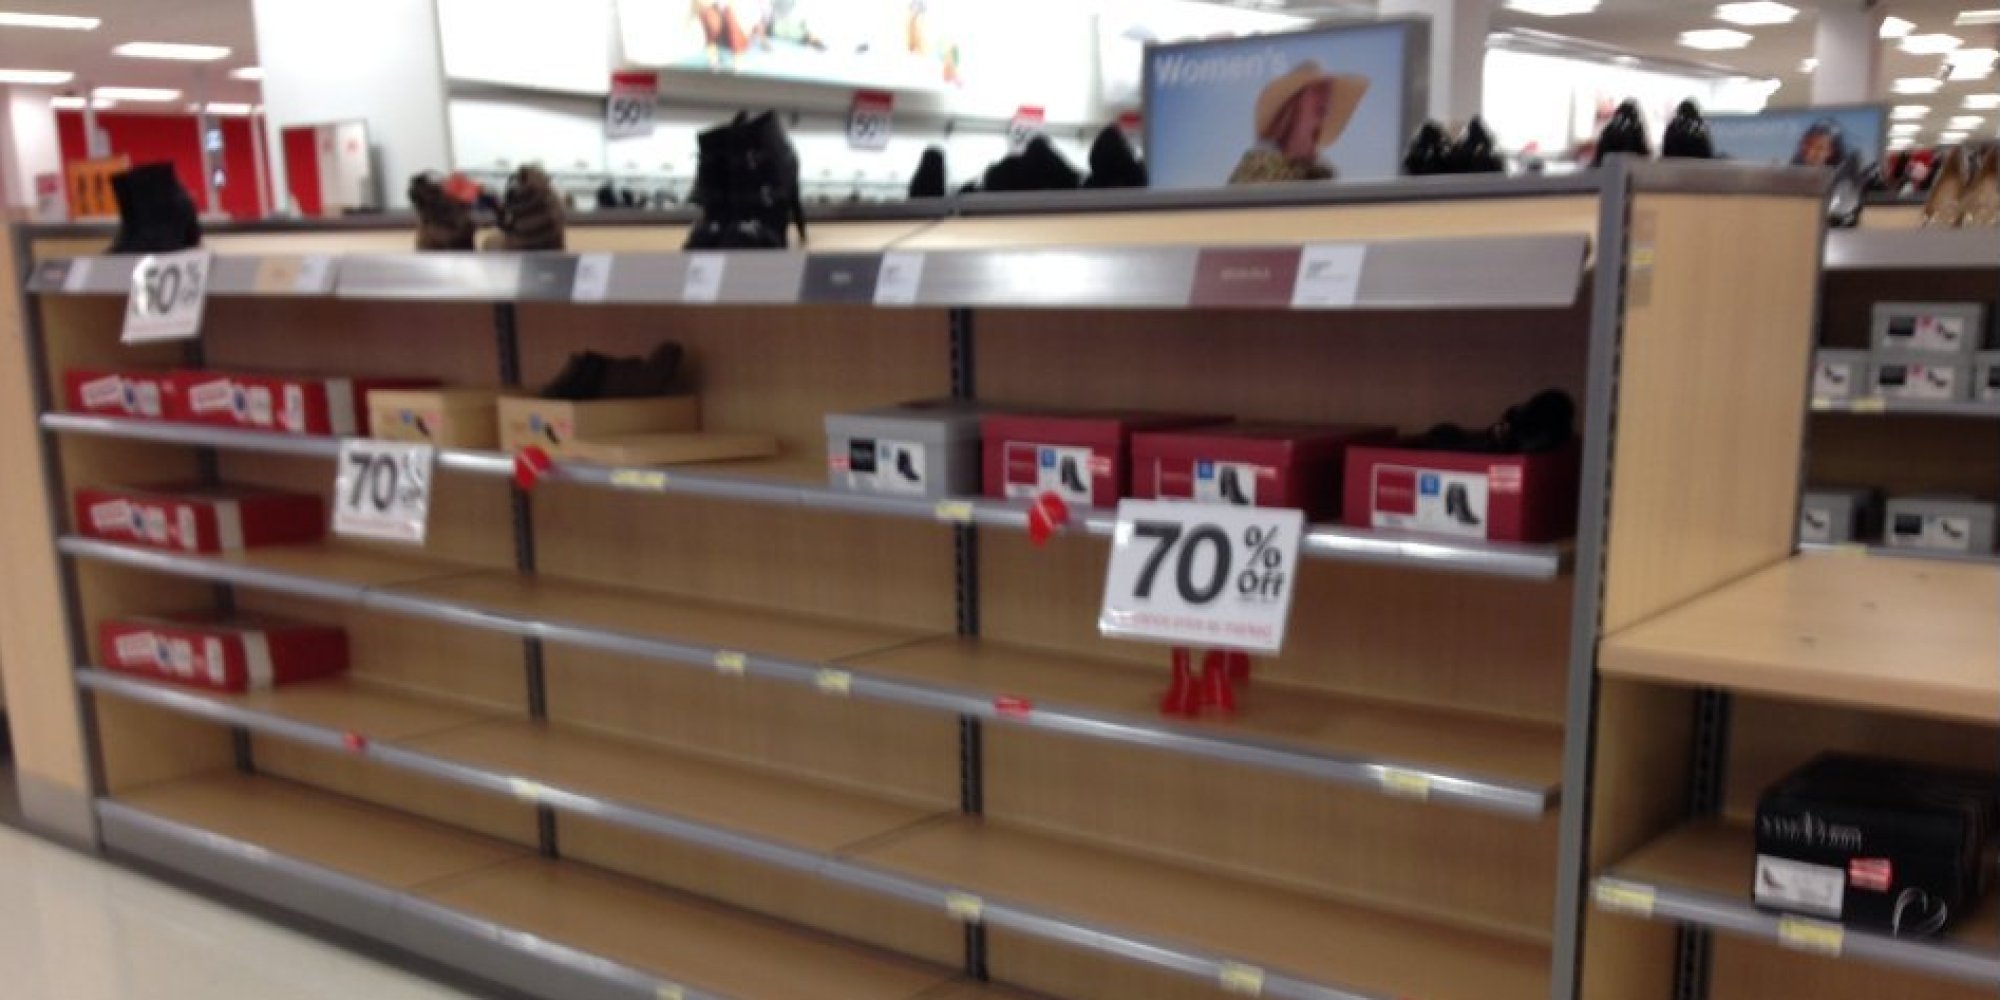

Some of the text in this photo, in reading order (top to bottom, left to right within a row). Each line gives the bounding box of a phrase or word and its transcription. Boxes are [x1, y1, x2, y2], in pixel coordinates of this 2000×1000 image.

[349, 452, 398, 511] 70
[1133, 519, 1233, 605] 70
[1237, 569, 1285, 597] Off
